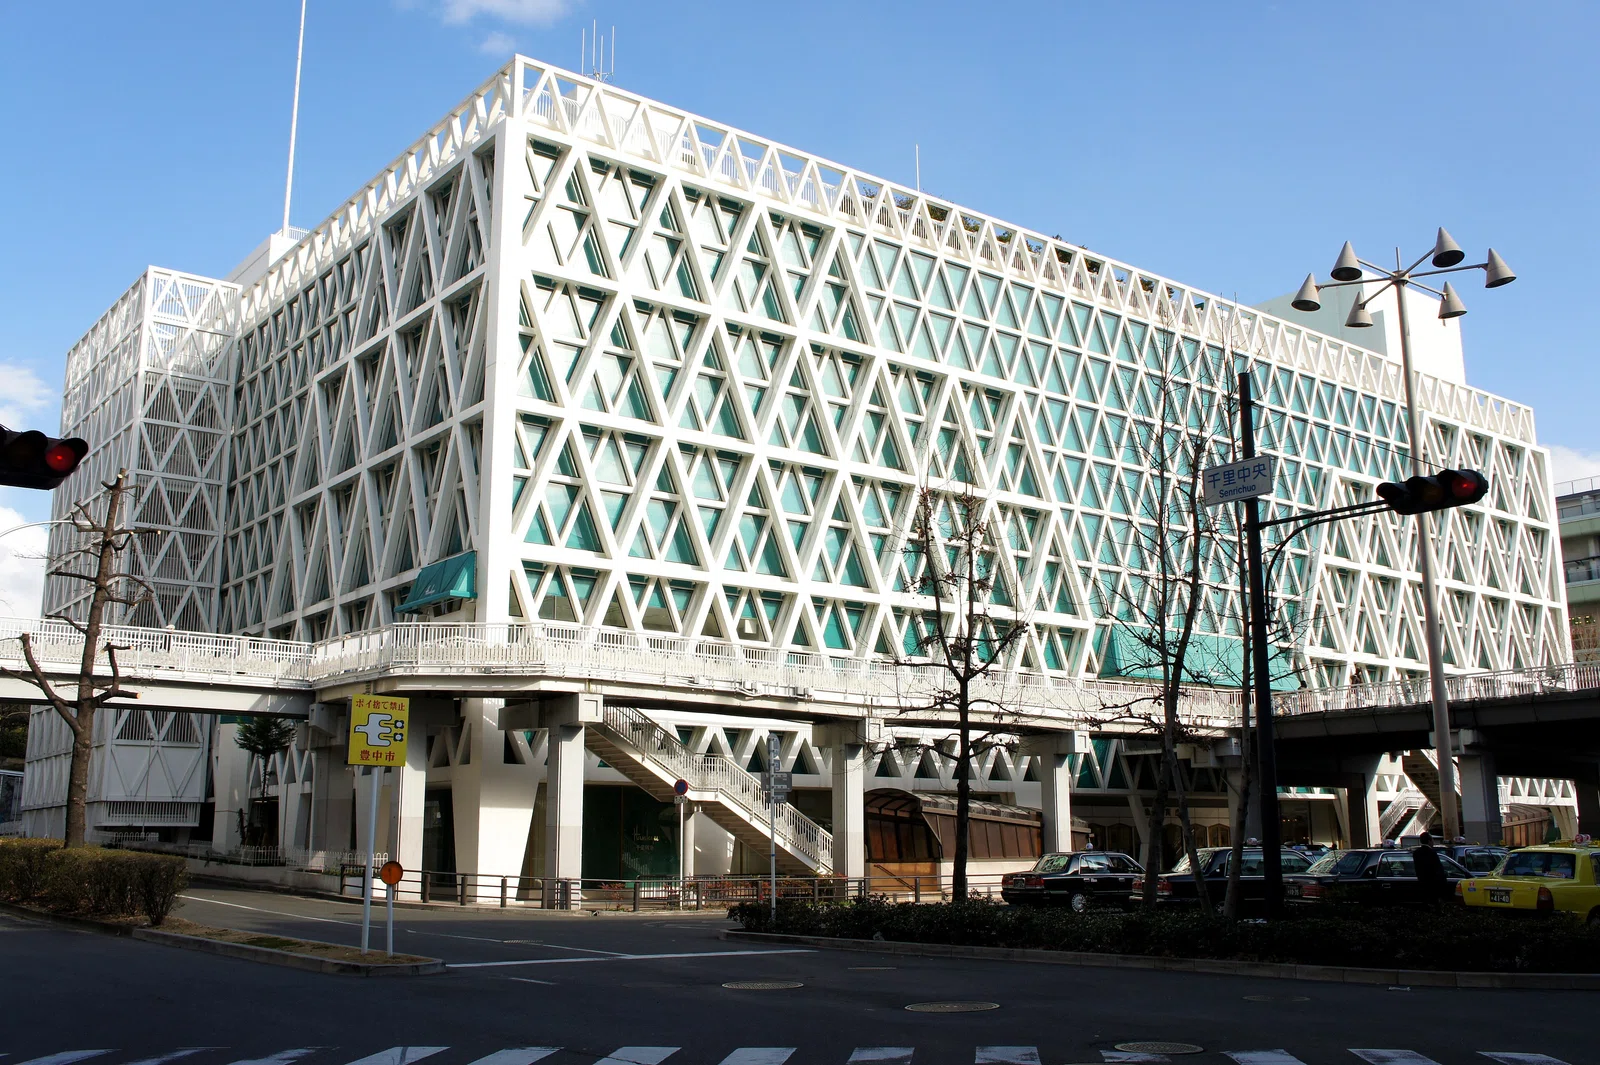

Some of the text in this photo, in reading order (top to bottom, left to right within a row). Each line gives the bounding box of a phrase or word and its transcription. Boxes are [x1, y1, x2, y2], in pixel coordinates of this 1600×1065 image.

[1208, 463, 1267, 489] 千里中央
[1219, 484, 1256, 498] Senrichuo
[356, 699, 405, 711] ポイ捨て禁止
[360, 750, 395, 762] 豊中市
